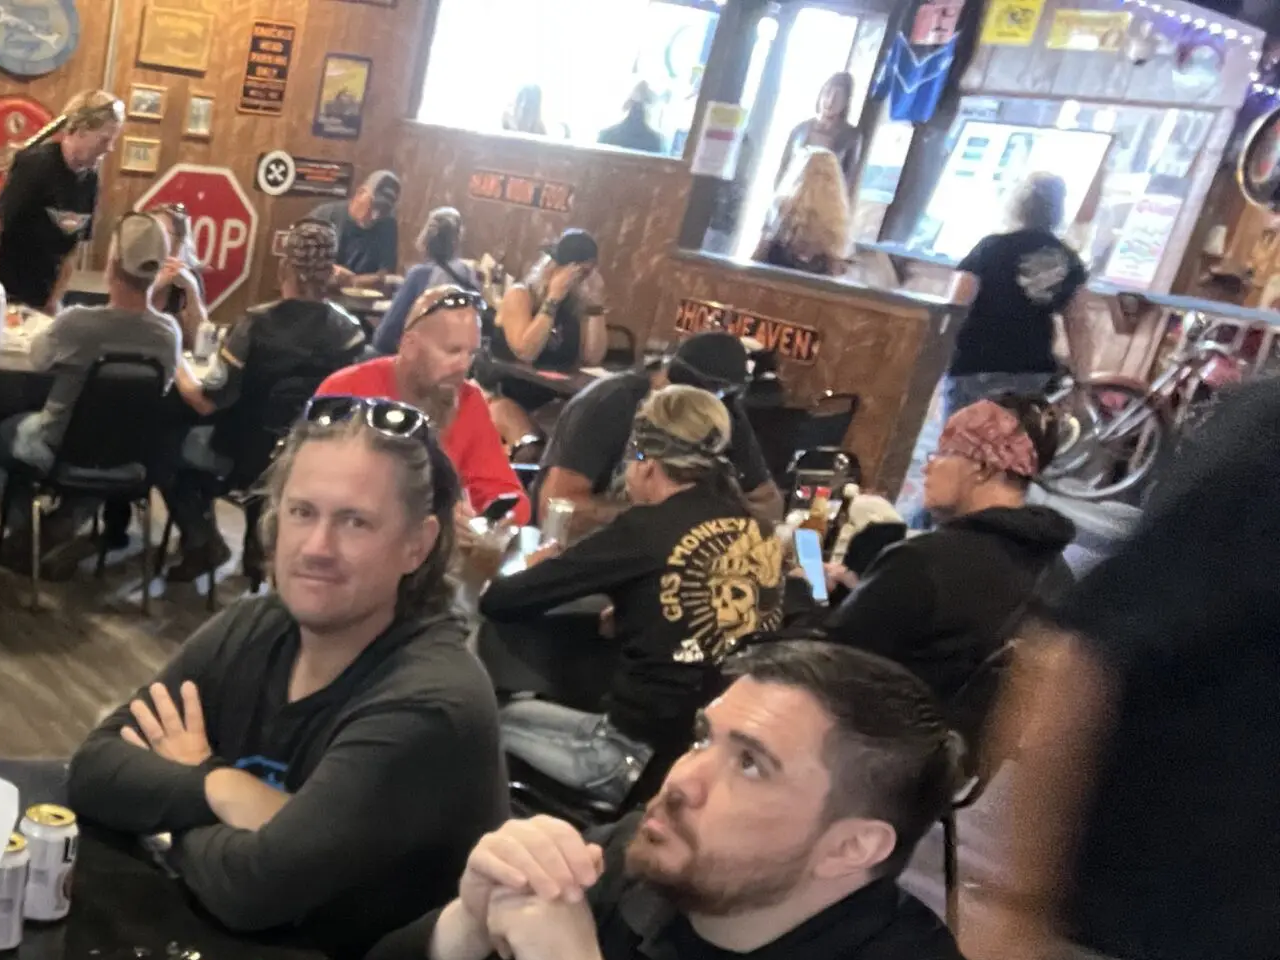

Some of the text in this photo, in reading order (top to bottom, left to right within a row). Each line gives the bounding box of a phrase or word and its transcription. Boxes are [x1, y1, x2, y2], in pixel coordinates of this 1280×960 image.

[194, 215, 248, 271] OP
[660, 517, 751, 622] GAS MONKEY
